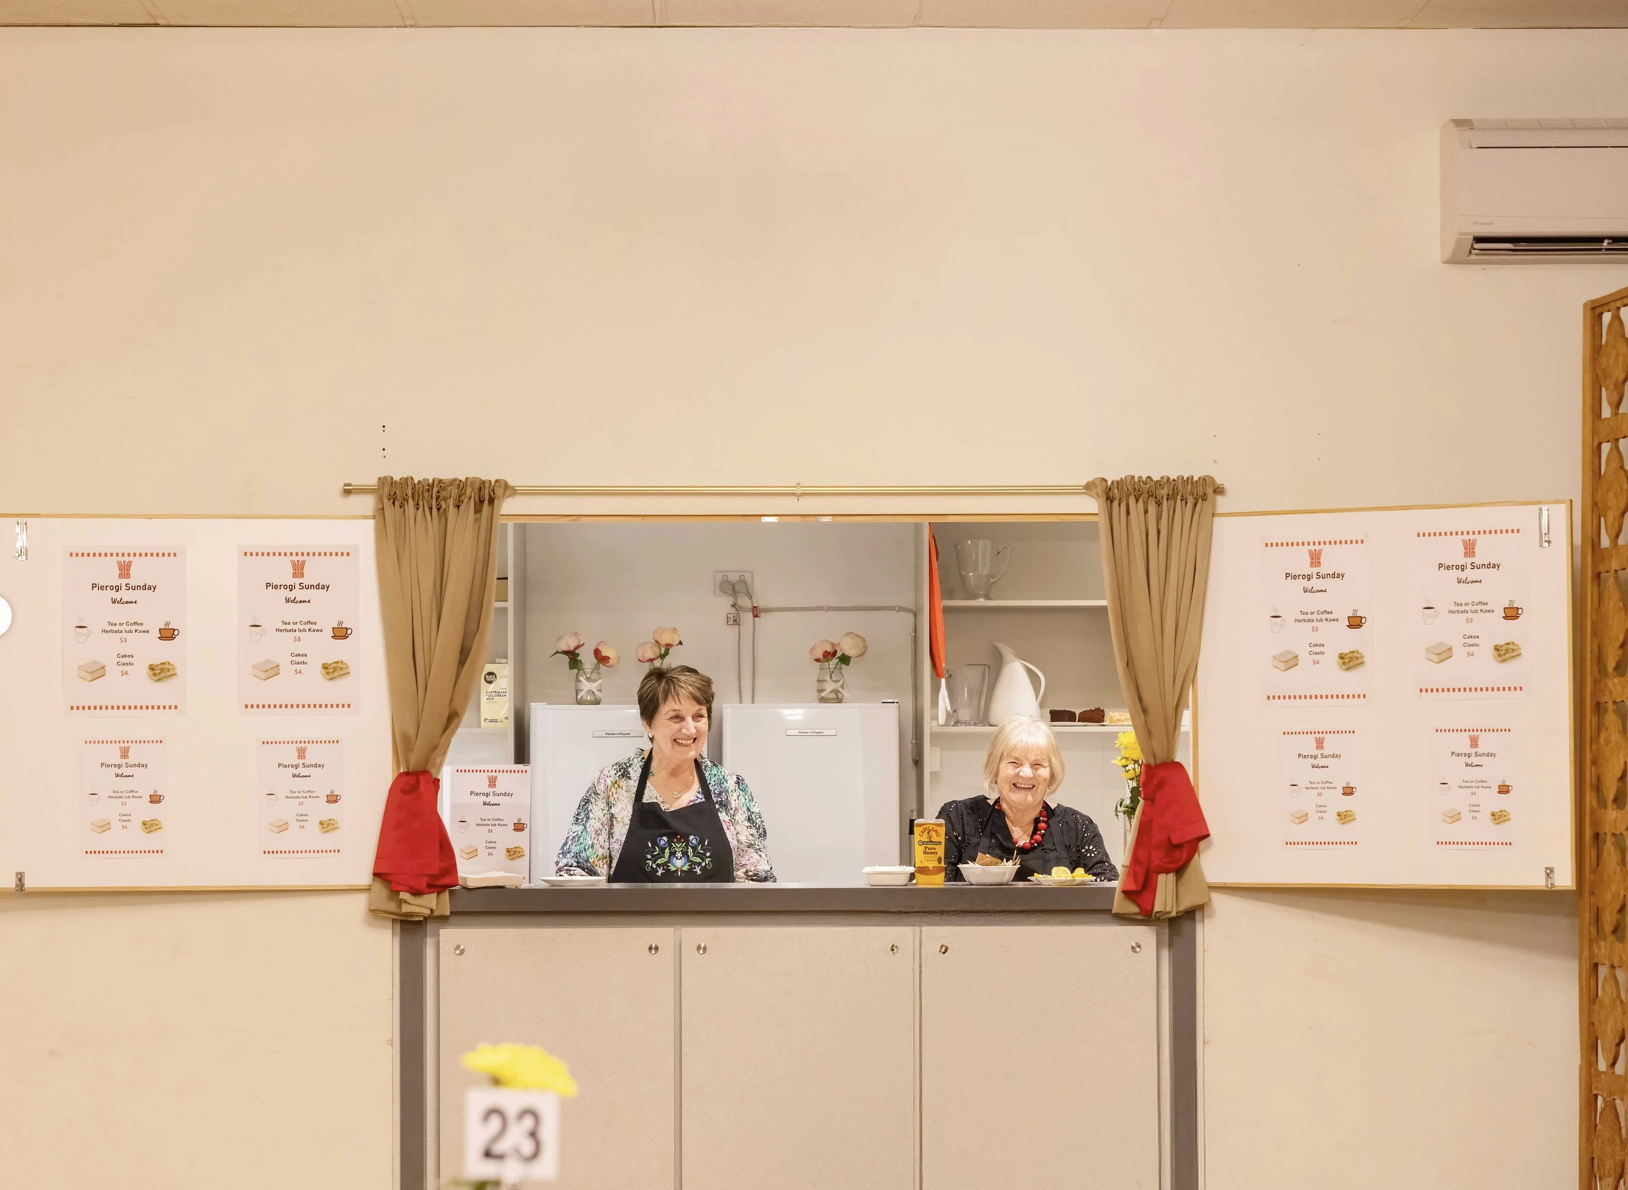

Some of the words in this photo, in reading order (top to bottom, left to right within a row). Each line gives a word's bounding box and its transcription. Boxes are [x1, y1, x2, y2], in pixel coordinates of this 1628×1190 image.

[1438, 562, 1468, 572] Pierogi
[1470, 561, 1501, 571] Sunday
[1285, 572, 1313, 581] Pierogi
[1316, 571, 1345, 580] Sunday
[91, 582, 123, 592] Pierogi
[125, 583, 157, 592] Sunday
[265, 582, 296, 591] Pierogi
[298, 582, 330, 592] Sunday
[482, 1105, 541, 1163] 23
